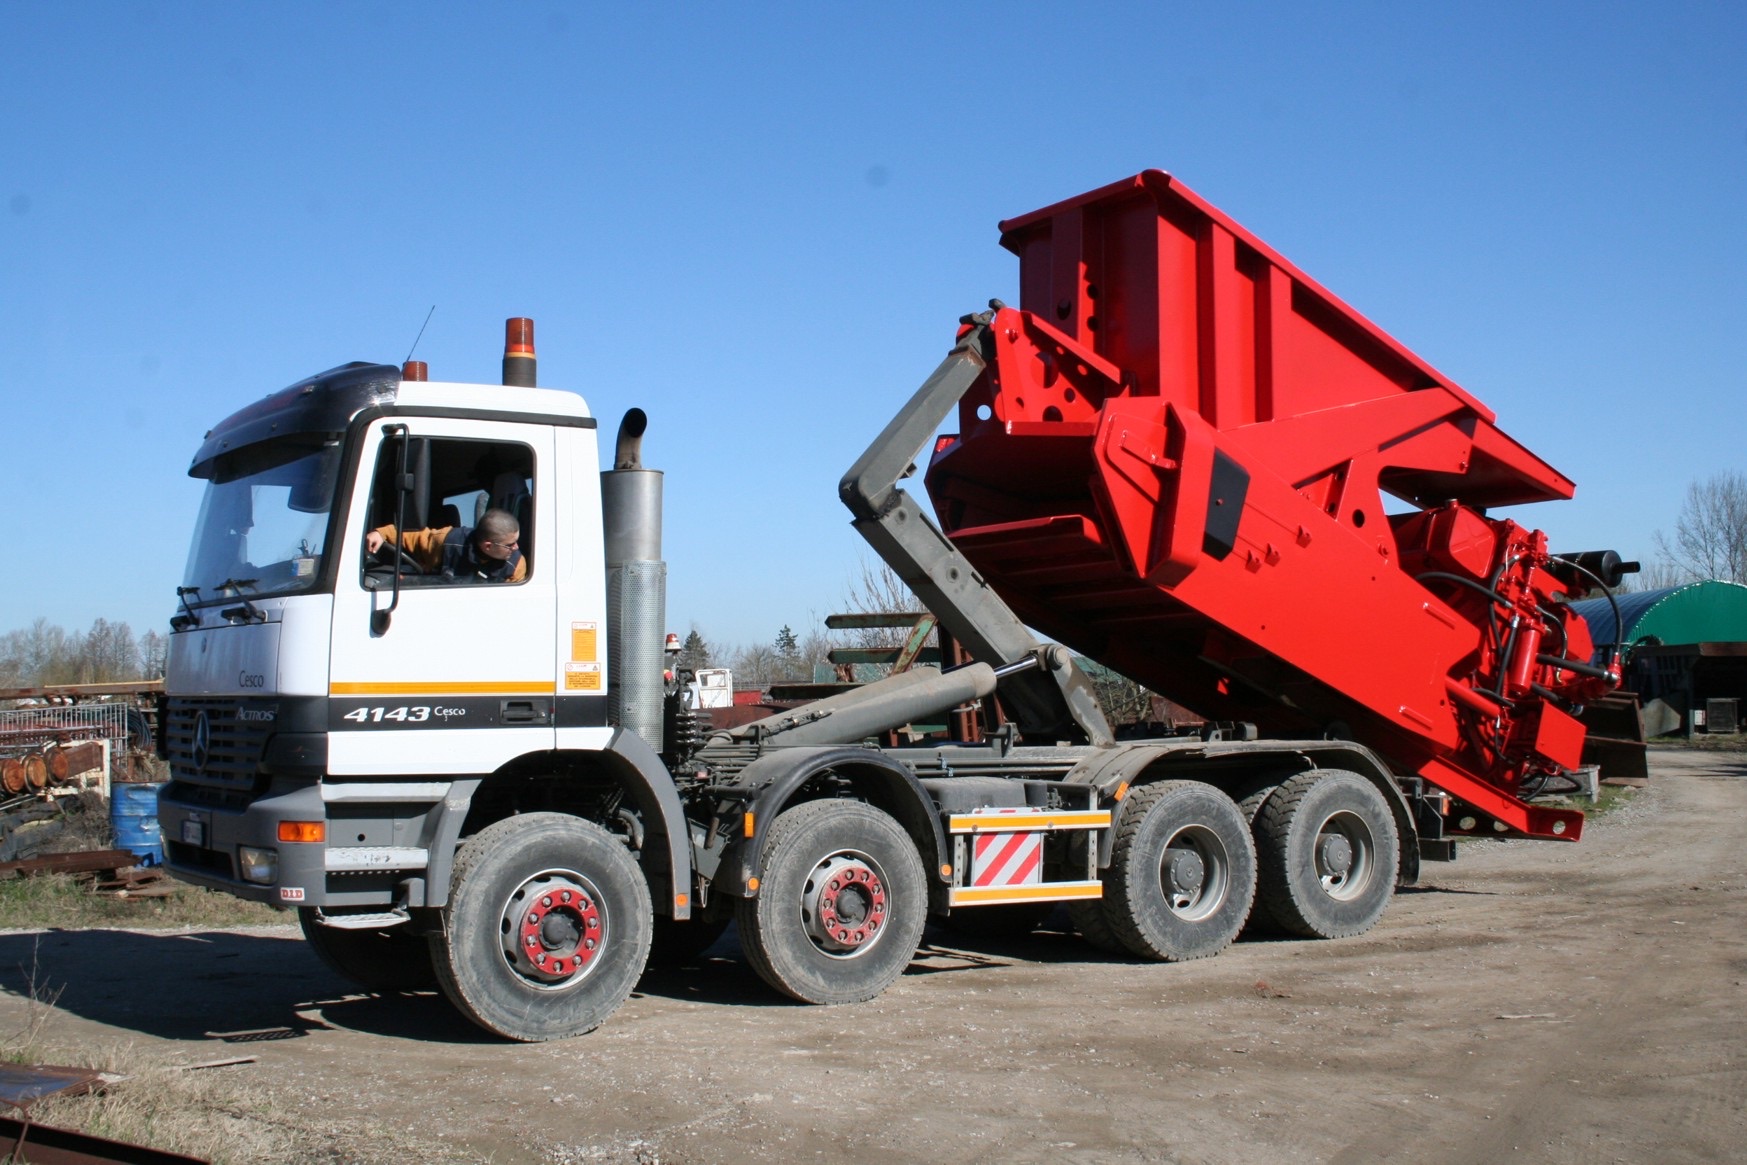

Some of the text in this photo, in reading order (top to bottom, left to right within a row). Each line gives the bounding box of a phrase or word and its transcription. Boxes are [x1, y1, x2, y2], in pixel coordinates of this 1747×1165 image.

[239, 670, 264, 688] Cesco
[343, 706, 466, 722] 4143 Cesco
